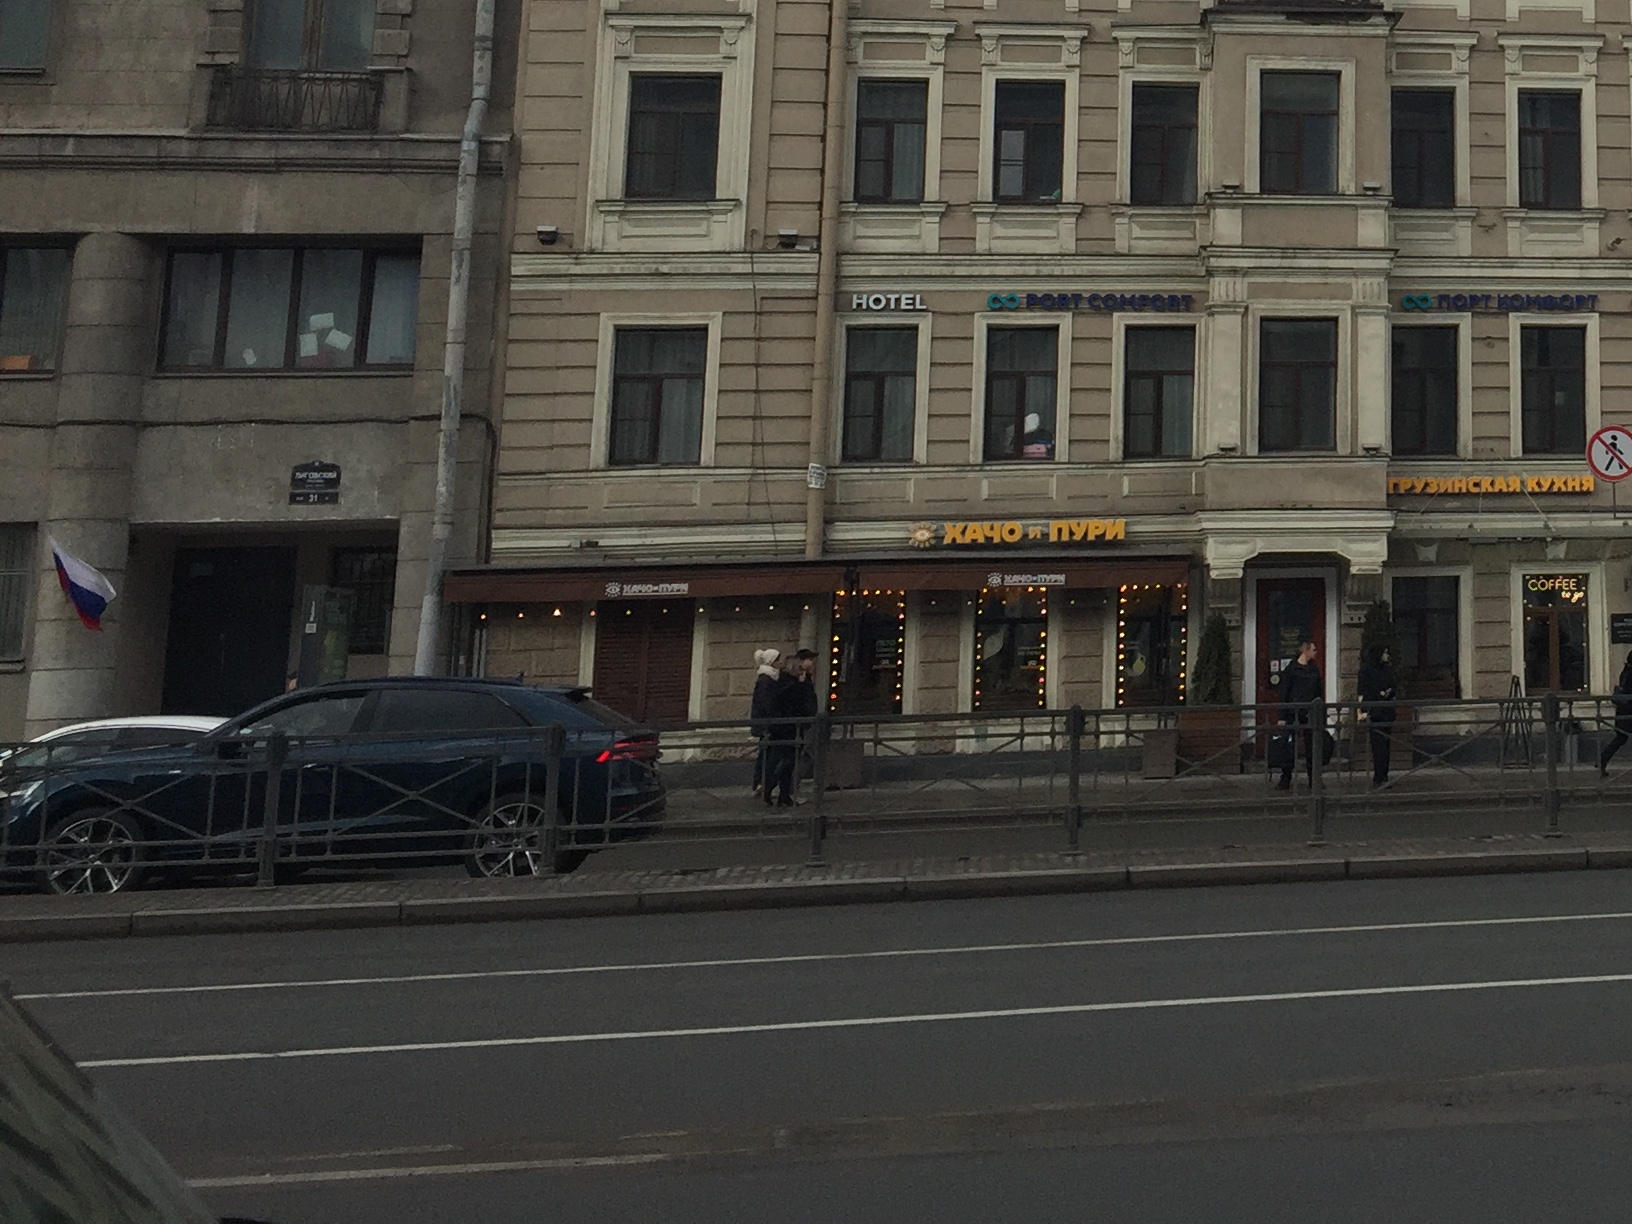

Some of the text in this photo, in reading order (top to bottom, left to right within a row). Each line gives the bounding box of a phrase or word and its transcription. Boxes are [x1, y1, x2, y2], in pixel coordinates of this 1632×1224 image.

[852, 294, 926, 310] HOTEL
[1026, 293, 1194, 311] PORT COMFORT
[1437, 294, 1598, 310] ПОРТ КОМФОРТ
[1388, 475, 1594, 493] ГРУЗИНСКАЯ КУХНЯ
[309, 494, 318, 502] 31
[943, 521, 1022, 544] ХАЧО
[1049, 519, 1125, 542] ПУРИ
[1528, 579, 1577, 591] COFFEE
[1571, 592, 1584, 603] go
